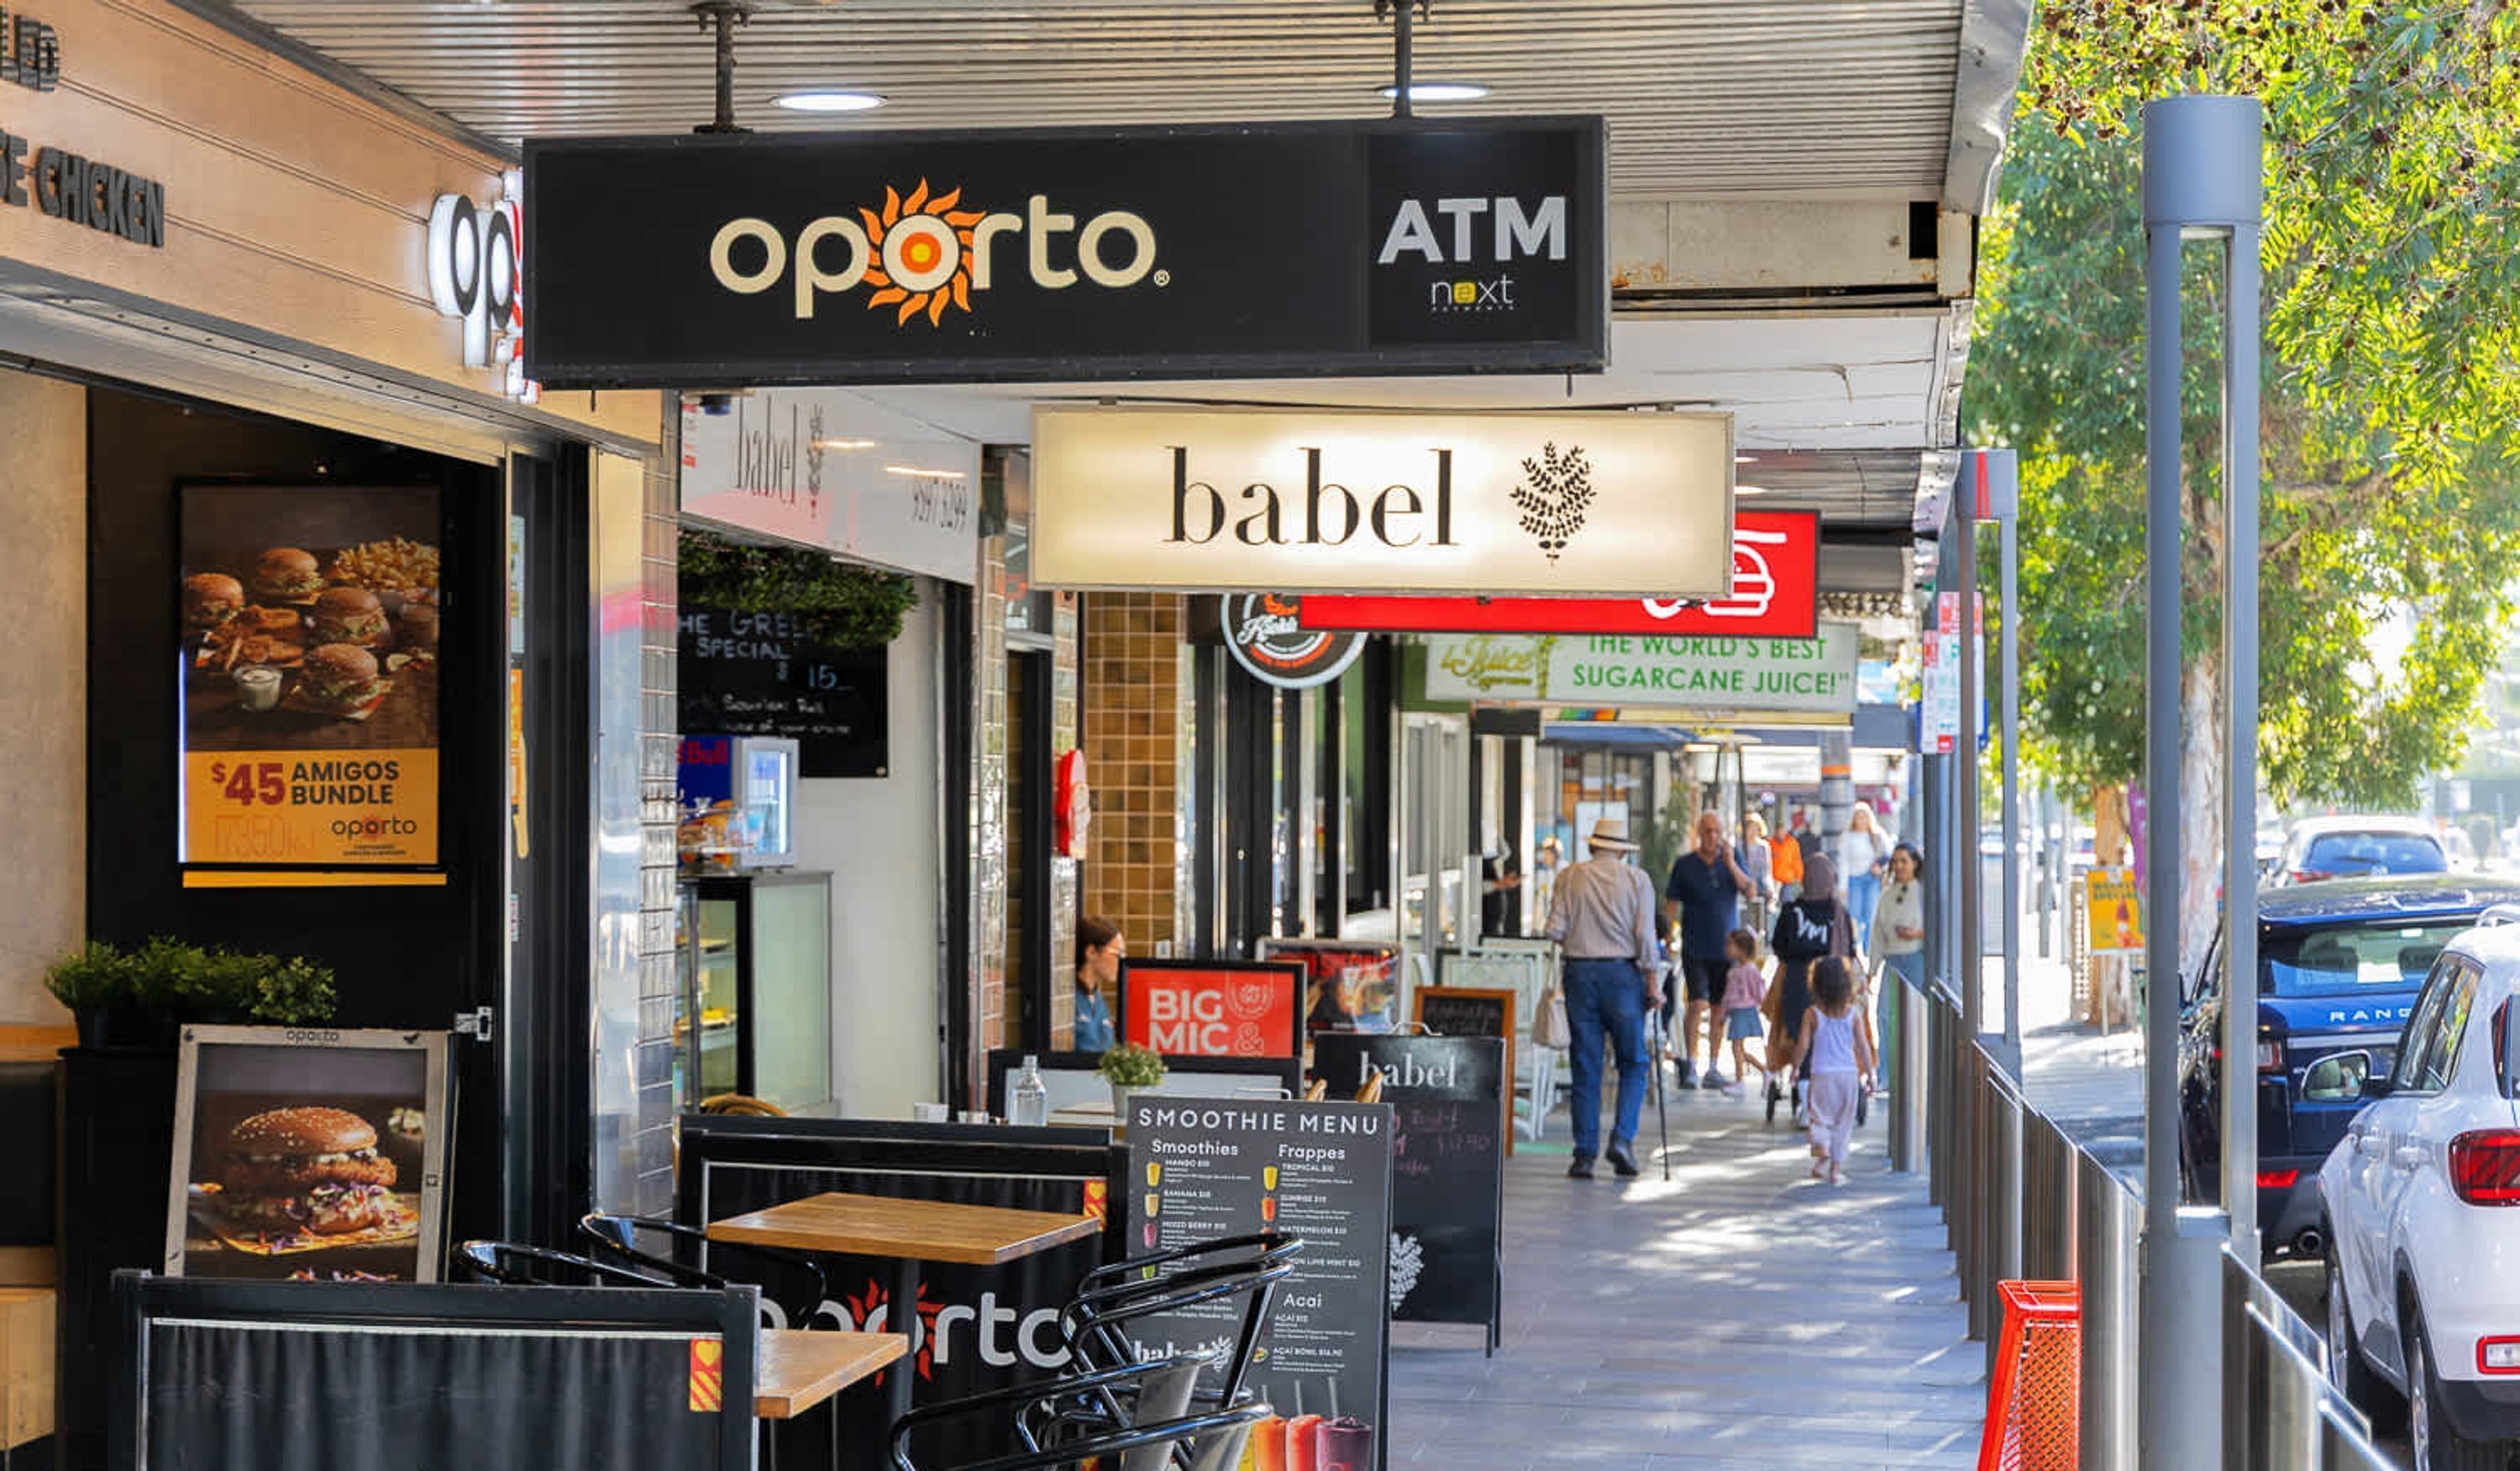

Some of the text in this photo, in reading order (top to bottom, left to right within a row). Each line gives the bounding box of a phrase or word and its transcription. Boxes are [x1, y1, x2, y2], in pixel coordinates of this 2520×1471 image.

[35, 145, 165, 249] CHICKEN
[1378, 196, 1567, 264] ATM
[710, 194, 1158, 319] oporto
[1431, 273, 1515, 306] next
[1162, 444, 1462, 547] babel
[696, 636, 794, 660] SPECIAL
[1588, 636, 1825, 660] THE WORLD'S BEST
[1572, 664, 1745, 692] SUGARCANE
[212, 760, 400, 806] $45 AMIGOS
[291, 785, 394, 806] BUNDLE
[331, 813, 417, 840] oporto
[1149, 989, 1223, 1021] BIG
[1149, 1022, 1228, 1054] MIC
[1360, 1051, 1456, 1089] babel
[1139, 1106, 1286, 1132] SMOOTHIE
[1299, 1114, 1378, 1135] MENU
[1152, 1138, 1238, 1156] Smoothies
[1278, 1143, 1346, 1162] Frappes
